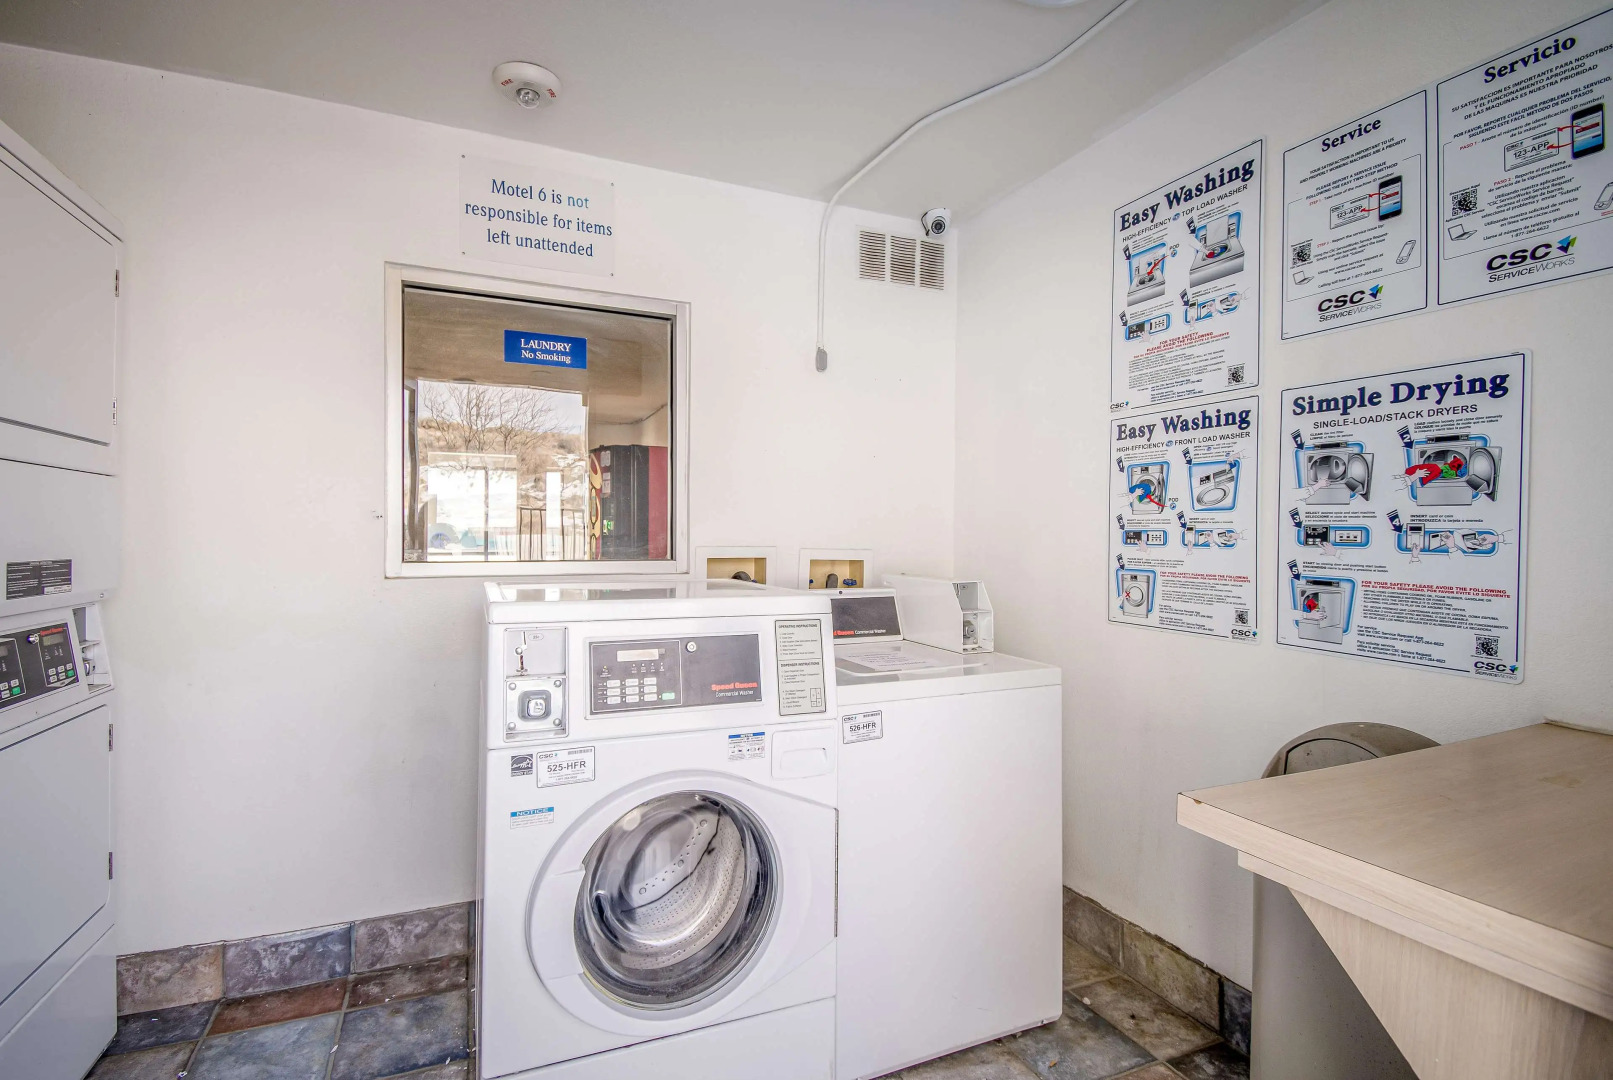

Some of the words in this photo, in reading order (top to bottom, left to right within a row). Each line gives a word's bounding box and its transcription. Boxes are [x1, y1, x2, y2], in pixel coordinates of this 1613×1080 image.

[1484, 37, 1576, 83] Servicio
[1452, 105, 1459, 113] SU
[1460, 88, 1502, 109] SATISFACCION
[1504, 84, 1511, 92] ES
[1512, 67, 1553, 88] IMPORTANTE
[1555, 60, 1573, 71] PARA
[1575, 44, 1613, 63] NOSOTROS
[1473, 108, 1484, 117] LAS
[1486, 94, 1518, 112] MAQUINAS
[1520, 91, 1527, 99] ES
[1529, 79, 1558, 95] NUESTRA
[1560, 64, 1597, 83] PRIORIDAD
[1488, 78, 1544, 105] FUNCIONAMIENTO
[1546, 61, 1585, 82] APROPIADO
[1454, 131, 1463, 139] POR
[1507, 102, 1538, 119] CUALQUIER
[1539, 91, 1569, 107] PROBLEMA
[1571, 86, 1581, 95] DEL
[1469, 124, 1496, 139] SIGUIENDO
[1498, 119, 1509, 128] ESTE
[1511, 113, 1525, 123] FACIL
[1527, 104, 1550, 118] METODO
[1561, 96, 1572, 105] DOS
[1574, 88, 1593, 100] PASOS
[1322, 120, 1381, 152] Service
[1460, 142, 1473, 151] PASO
[492, 179, 532, 199] Motel
[539, 188, 546, 201] 6
[552, 190, 562, 204] is
[568, 195, 589, 209] not
[1120, 202, 1160, 231] Easy
[1165, 159, 1255, 209] Washing
[465, 203, 548, 226] responsible
[554, 215, 572, 229] for
[577, 218, 612, 236] items
[1123, 217, 1171, 242] HIGH-EFFICIENCY
[1182, 208, 1194, 216] TOP
[1197, 199, 1215, 210] LOAD
[1217, 184, 1247, 202] WASHER
[487, 229, 511, 245] left
[515, 236, 593, 257] unattended
[1487, 244, 1552, 271] CSC
[1318, 291, 1365, 312] CSC
[521, 339, 571, 351] LAUNDRY
[521, 350, 533, 358] No
[536, 352, 571, 364] Smoking
[1293, 387, 1381, 416] Simple
[1390, 374, 1509, 405] Drying
[1117, 424, 1156, 442] Easy
[1161, 409, 1251, 434] Washing
[1314, 410, 1423, 429] SINGLE-LOAD/STACK
[1427, 404, 1477, 418] DRYERS
[1117, 442, 1165, 452] HIGH-EFFICIENCY
[1219, 432, 1250, 441] WASHER
[1402, 434, 1411, 442] 2
[1469, 587, 1506, 595] FOLLOWING
[1231, 629, 1251, 637] CSC
[1474, 661, 1507, 672] CSC
[850, 722, 876, 732] 526-HFR
[547, 760, 586, 772] 525-HFR
[516, 808, 548, 816] NOTICE
